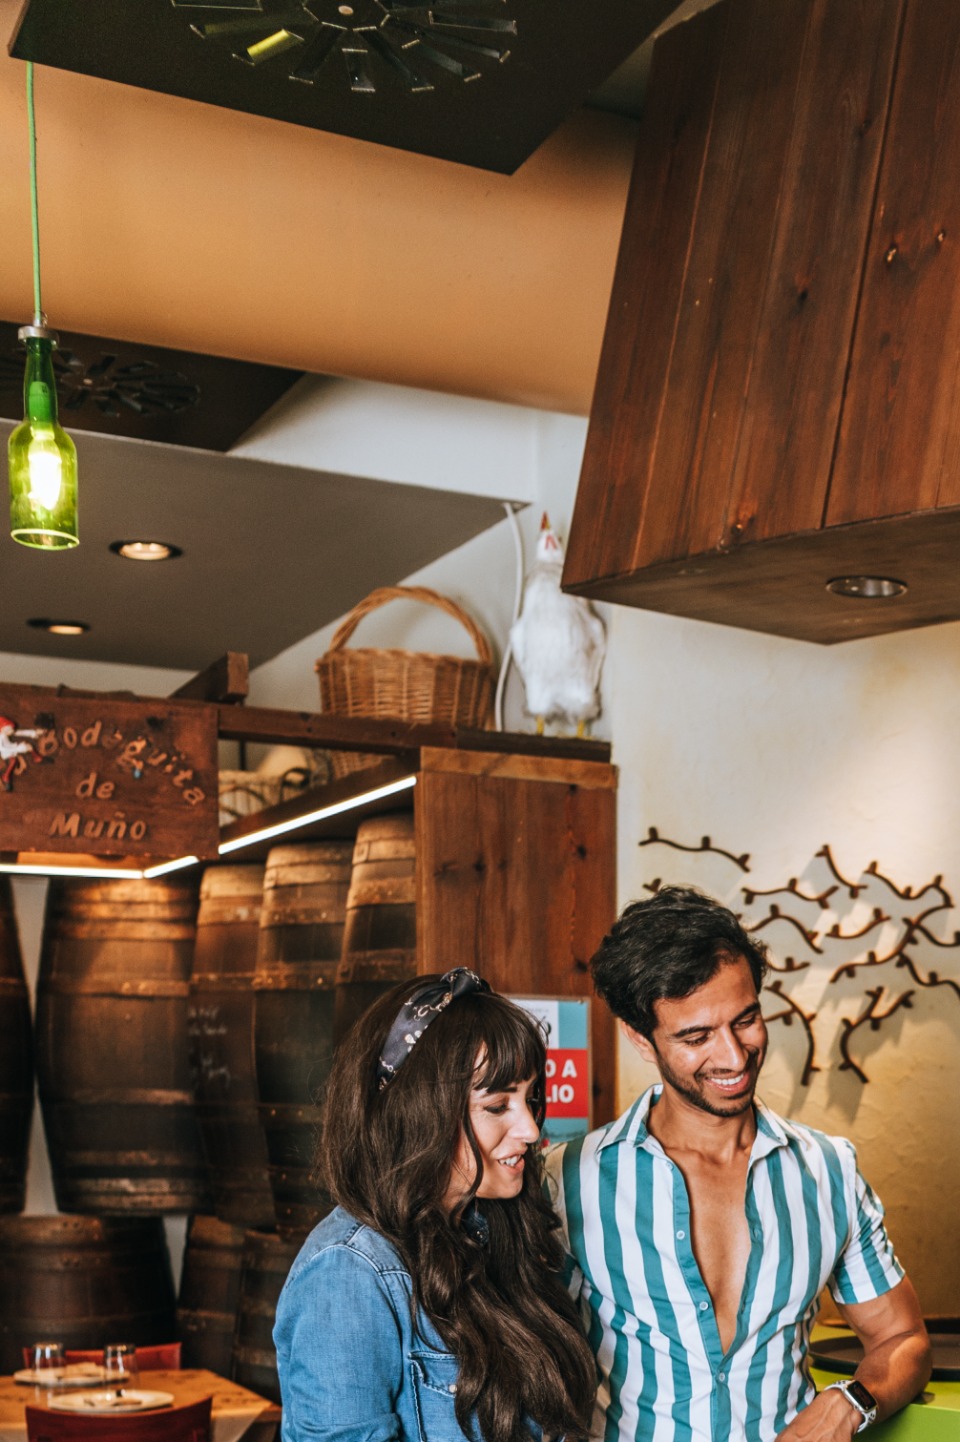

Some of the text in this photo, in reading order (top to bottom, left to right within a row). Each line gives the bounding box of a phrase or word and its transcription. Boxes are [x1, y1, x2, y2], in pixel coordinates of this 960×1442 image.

[76, 772, 115, 799] de
[50, 811, 146, 840] Muño
[561, 1059, 577, 1078] A
